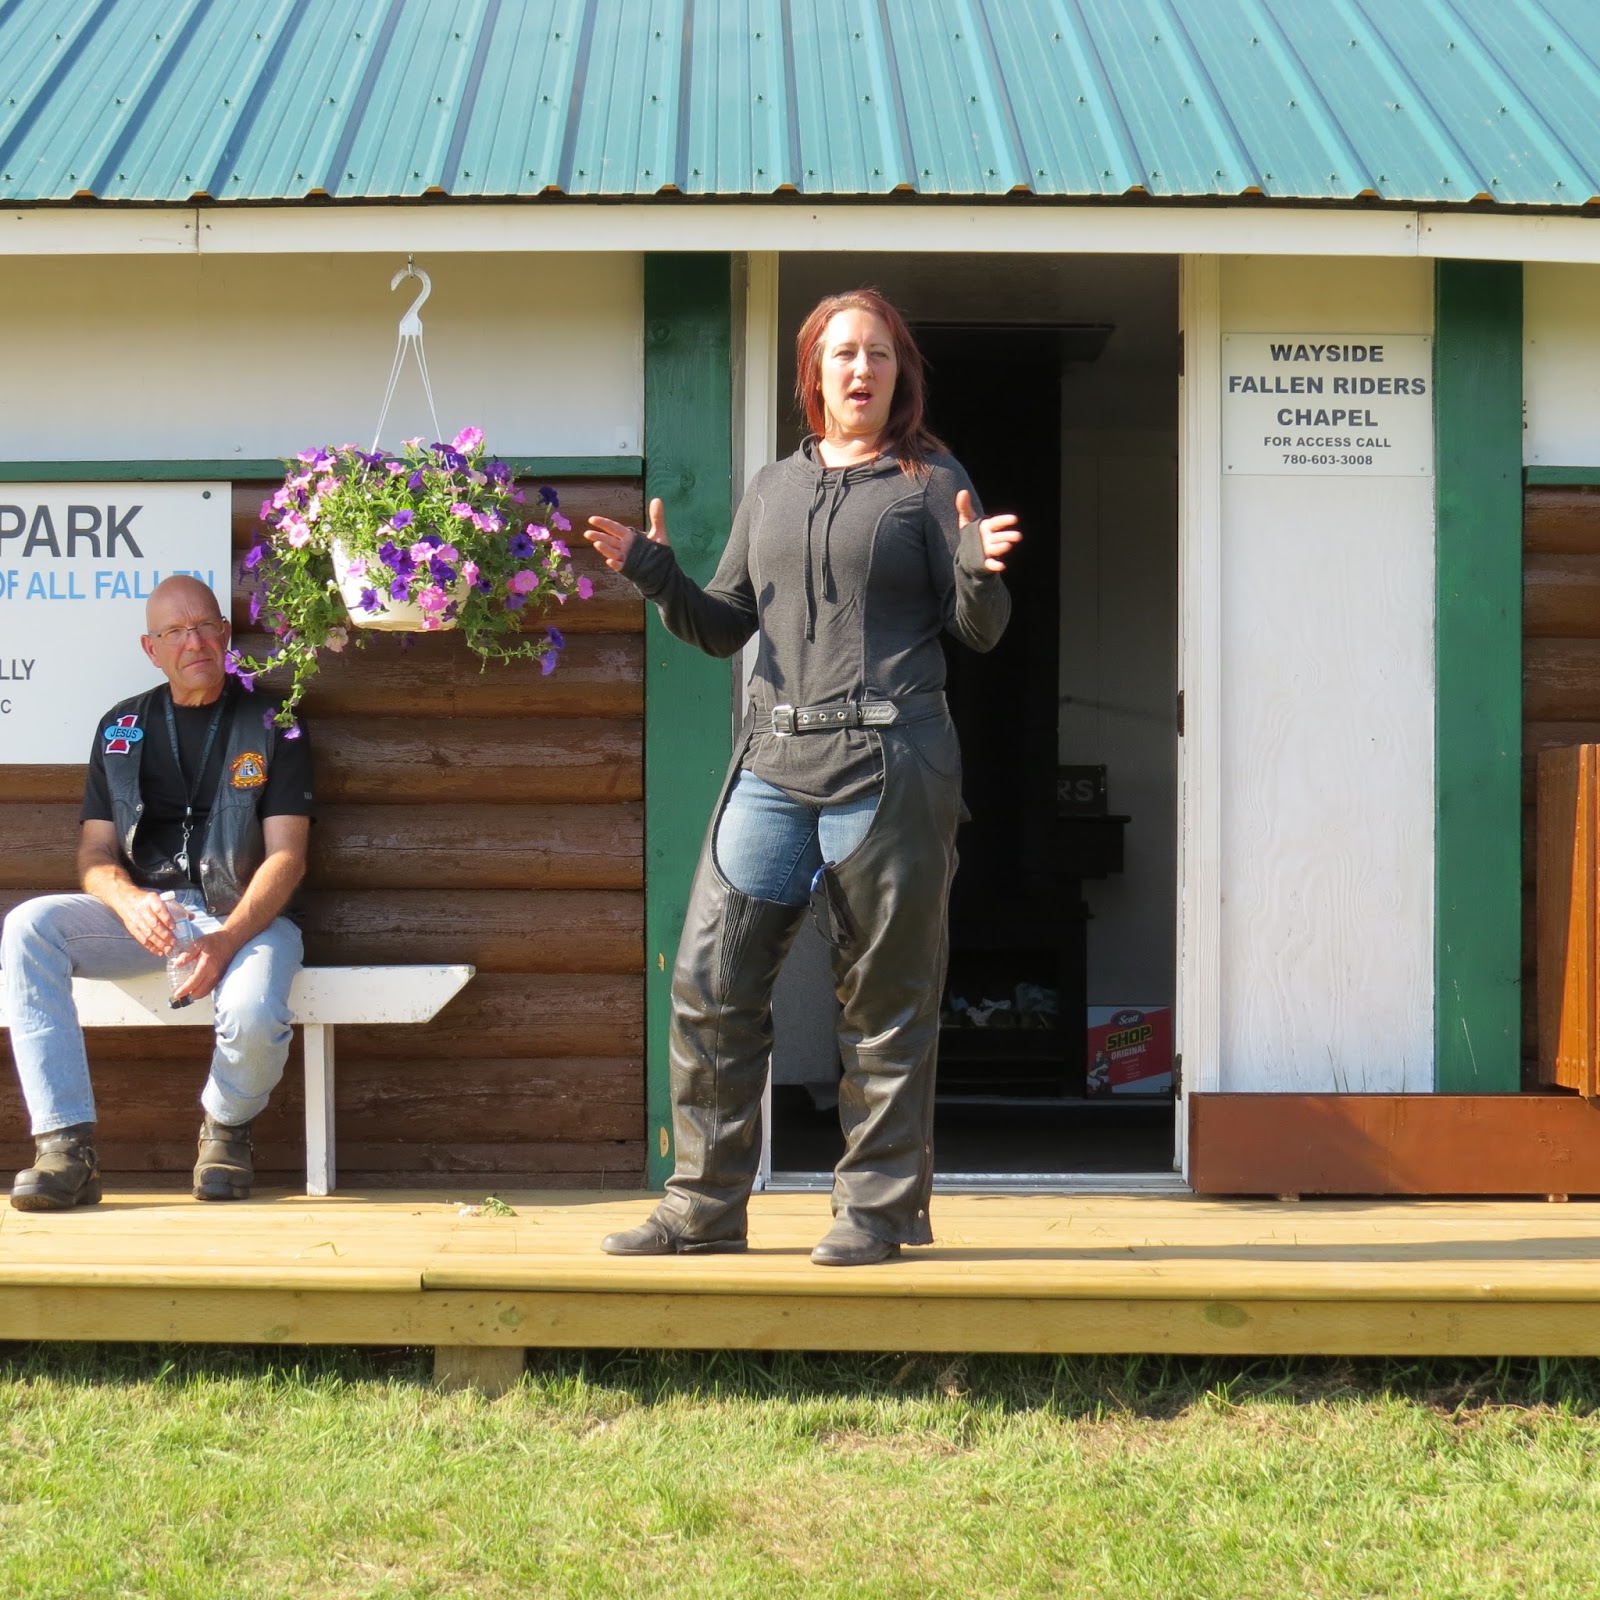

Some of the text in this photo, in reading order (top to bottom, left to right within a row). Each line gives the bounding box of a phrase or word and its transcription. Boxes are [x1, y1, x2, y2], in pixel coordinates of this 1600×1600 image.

[1270, 344, 1384, 362] WAYSIDE
[1229, 376, 1426, 395] FALLEN RIDERS
[1277, 408, 1378, 427] CHAPEL
[1264, 437, 1391, 448] FOR ACCESS CALL
[1282, 454, 1373, 465] 780-603-3008
[0, 505, 144, 558] PARK
[26, 571, 86, 600] ALL
[110, 728, 138, 739] JESUS
[1106, 1024, 1153, 1051] SHOP
[1111, 1044, 1147, 1060] ORIGINAL
